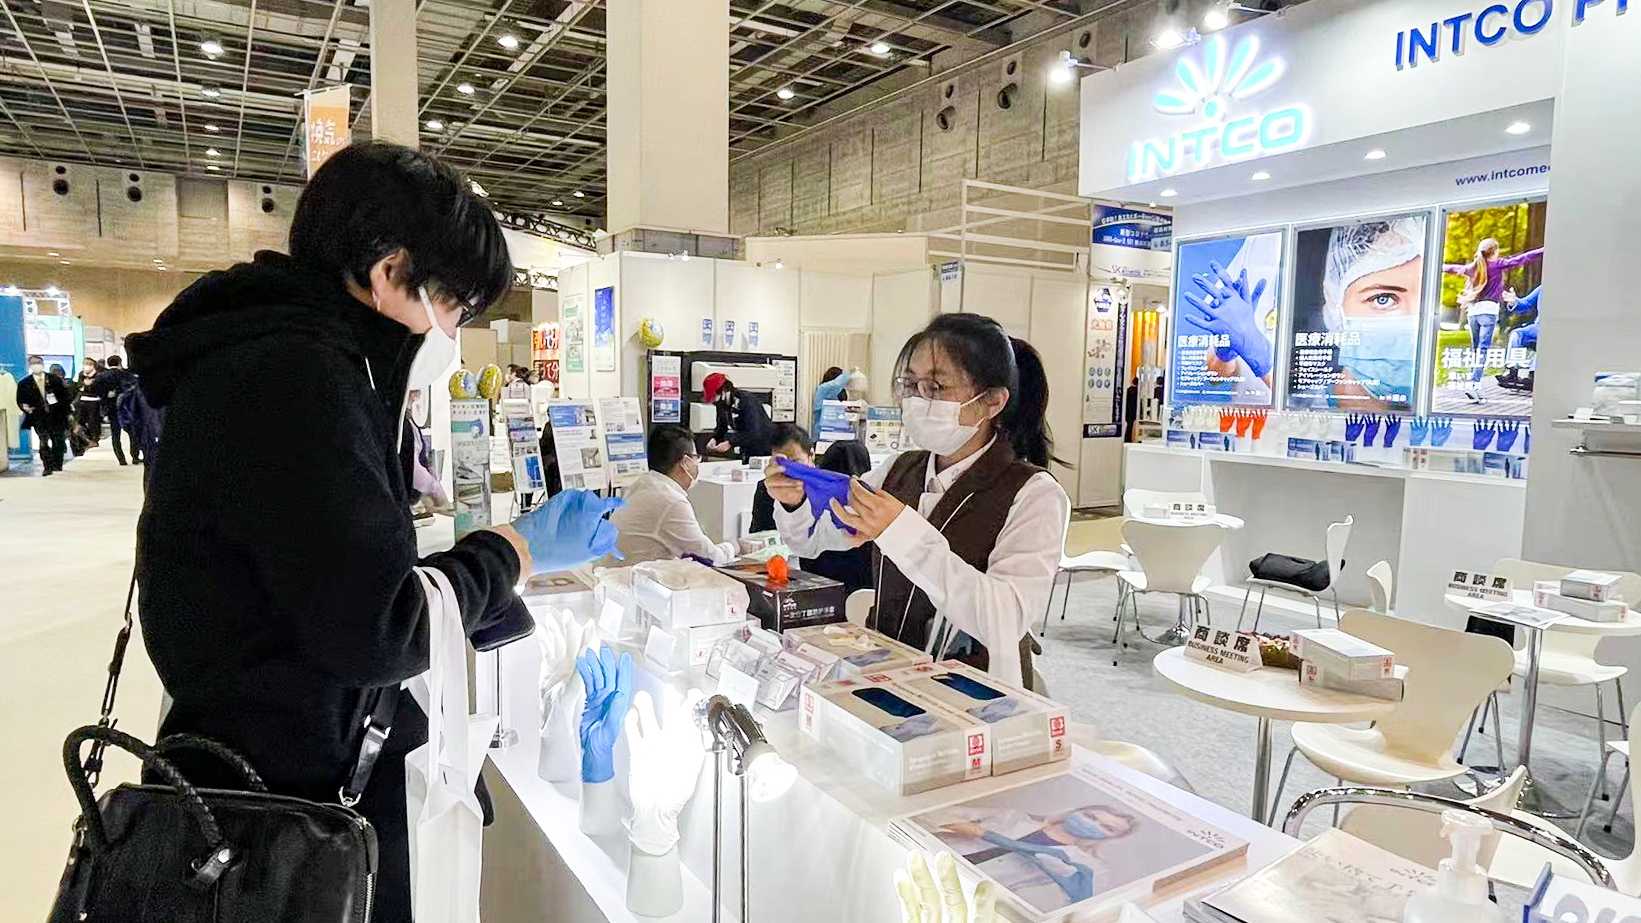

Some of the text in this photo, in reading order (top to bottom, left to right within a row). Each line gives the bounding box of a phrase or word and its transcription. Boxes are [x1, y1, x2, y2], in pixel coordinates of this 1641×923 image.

[1395, 0, 1553, 70] INTCO
[1127, 107, 1305, 179] INTCO
[1177, 333, 1231, 348] 医療消耗品
[1294, 331, 1361, 347] 医療消耗品
[1440, 347, 1532, 369] 福祉用具
[1453, 571, 1507, 589] 商談席
[1194, 625, 1251, 653] 商談席
[1188, 640, 1250, 664] BUSINESS MEETING
[1205, 654, 1225, 665] AREA
[1055, 739, 1062, 751] S
[972, 758, 982, 769] M
